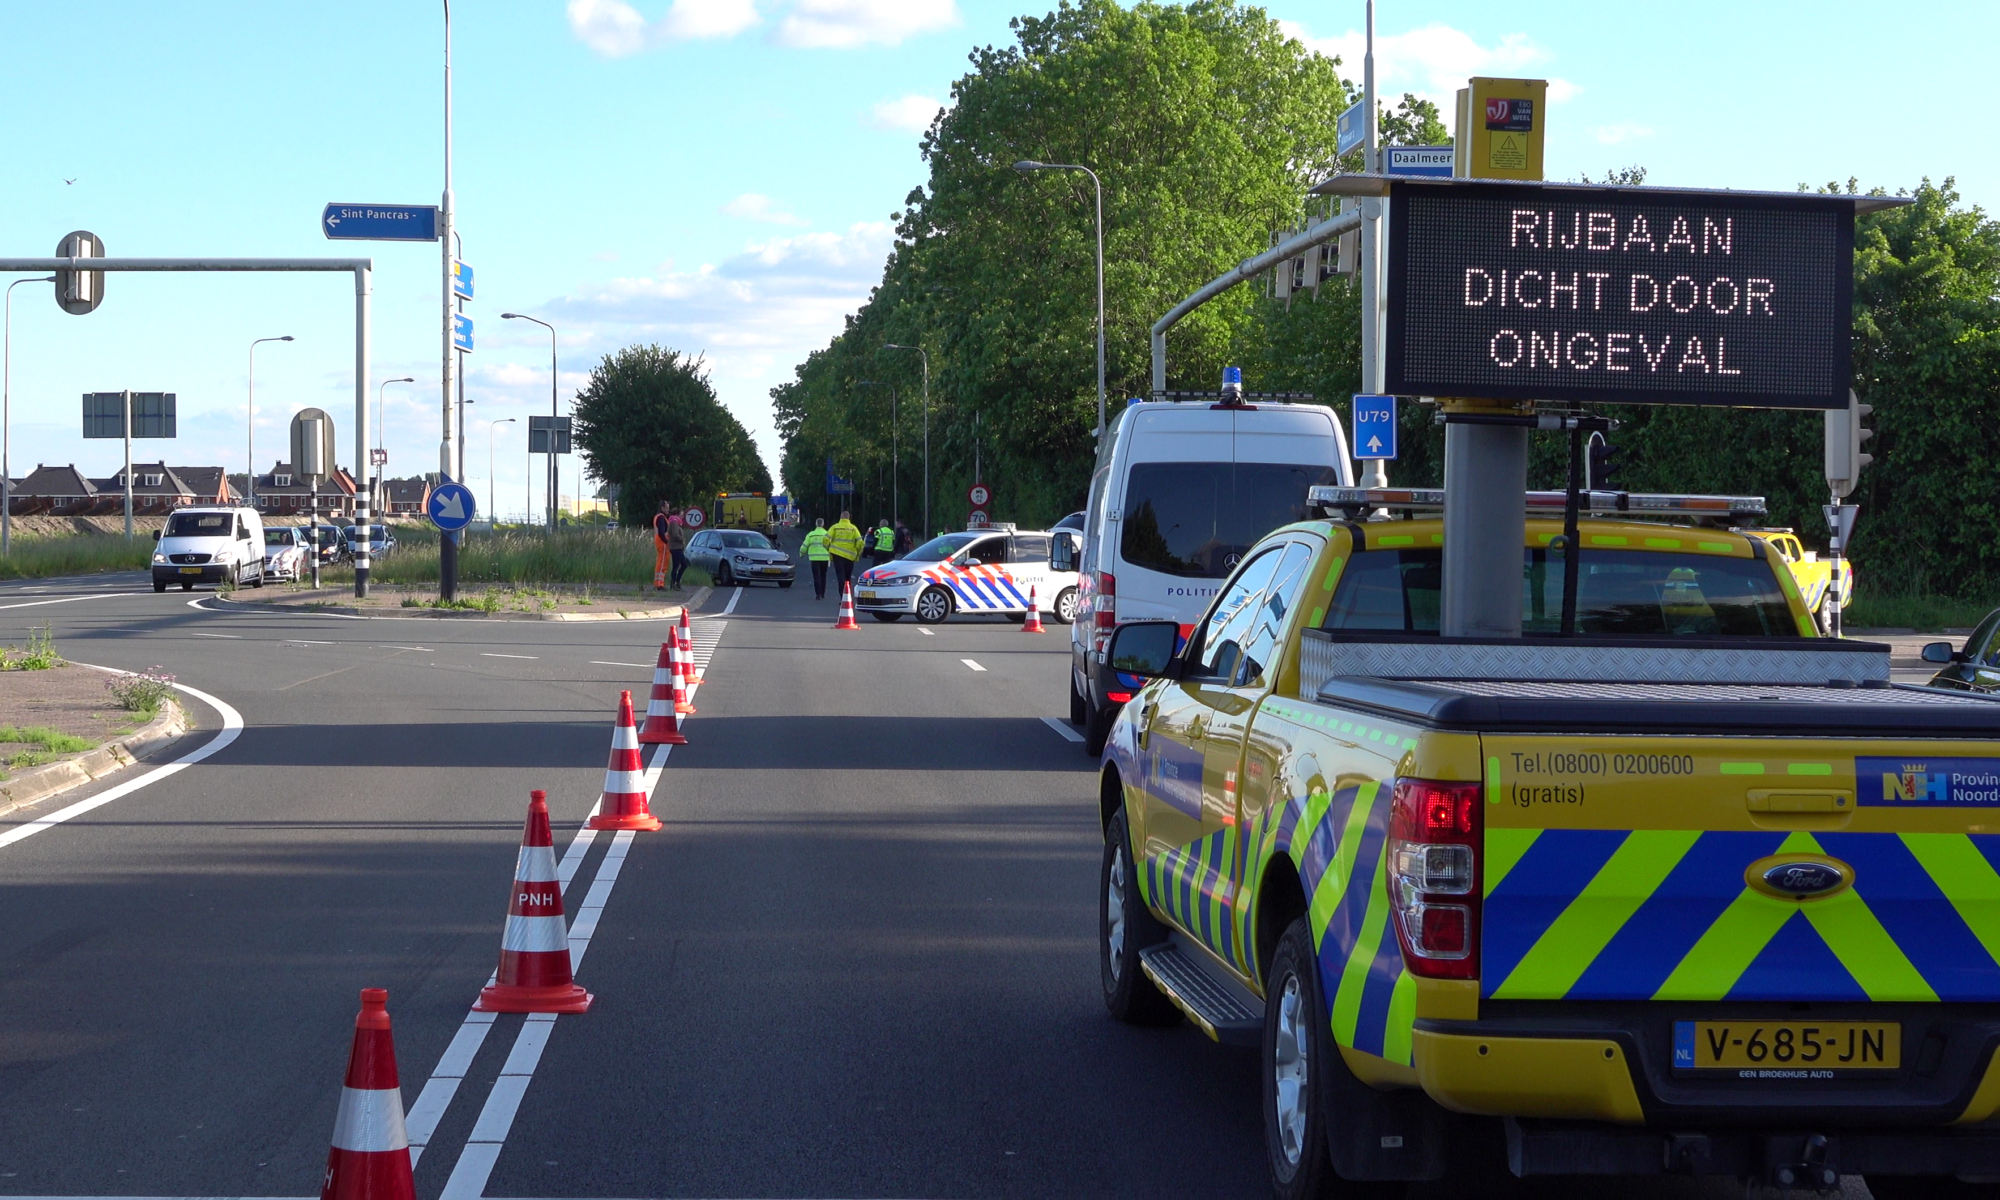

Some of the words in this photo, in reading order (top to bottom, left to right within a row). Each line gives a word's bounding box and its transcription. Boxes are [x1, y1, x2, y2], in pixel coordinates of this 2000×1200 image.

[1394, 153, 1452, 163] Daalmeer
[341, 209, 363, 219] Sint
[367, 209, 409, 220] Pancras
[1511, 210, 1732, 255] RIJBAAN
[1465, 268, 1610, 311] DICHT
[1630, 274, 1774, 316] DOOR
[1490, 329, 1741, 375] ONGEVAL
[1358, 410, 1390, 423] U79
[687, 513, 702, 523] 70
[971, 514, 986, 523] 70
[1015, 576, 1044, 584] POLITIE
[1511, 752, 1607, 776] Tel.(0800)
[1613, 754, 1694, 775] 0200600
[1952, 772, 2000, 786] Provin
[1511, 781, 1585, 807] (gratis)
[1783, 867, 1826, 887] Ford
[518, 893, 553, 906] PNH
[1706, 1028, 1884, 1062] V-685-JN
[1676, 1049, 1691, 1060] NL
